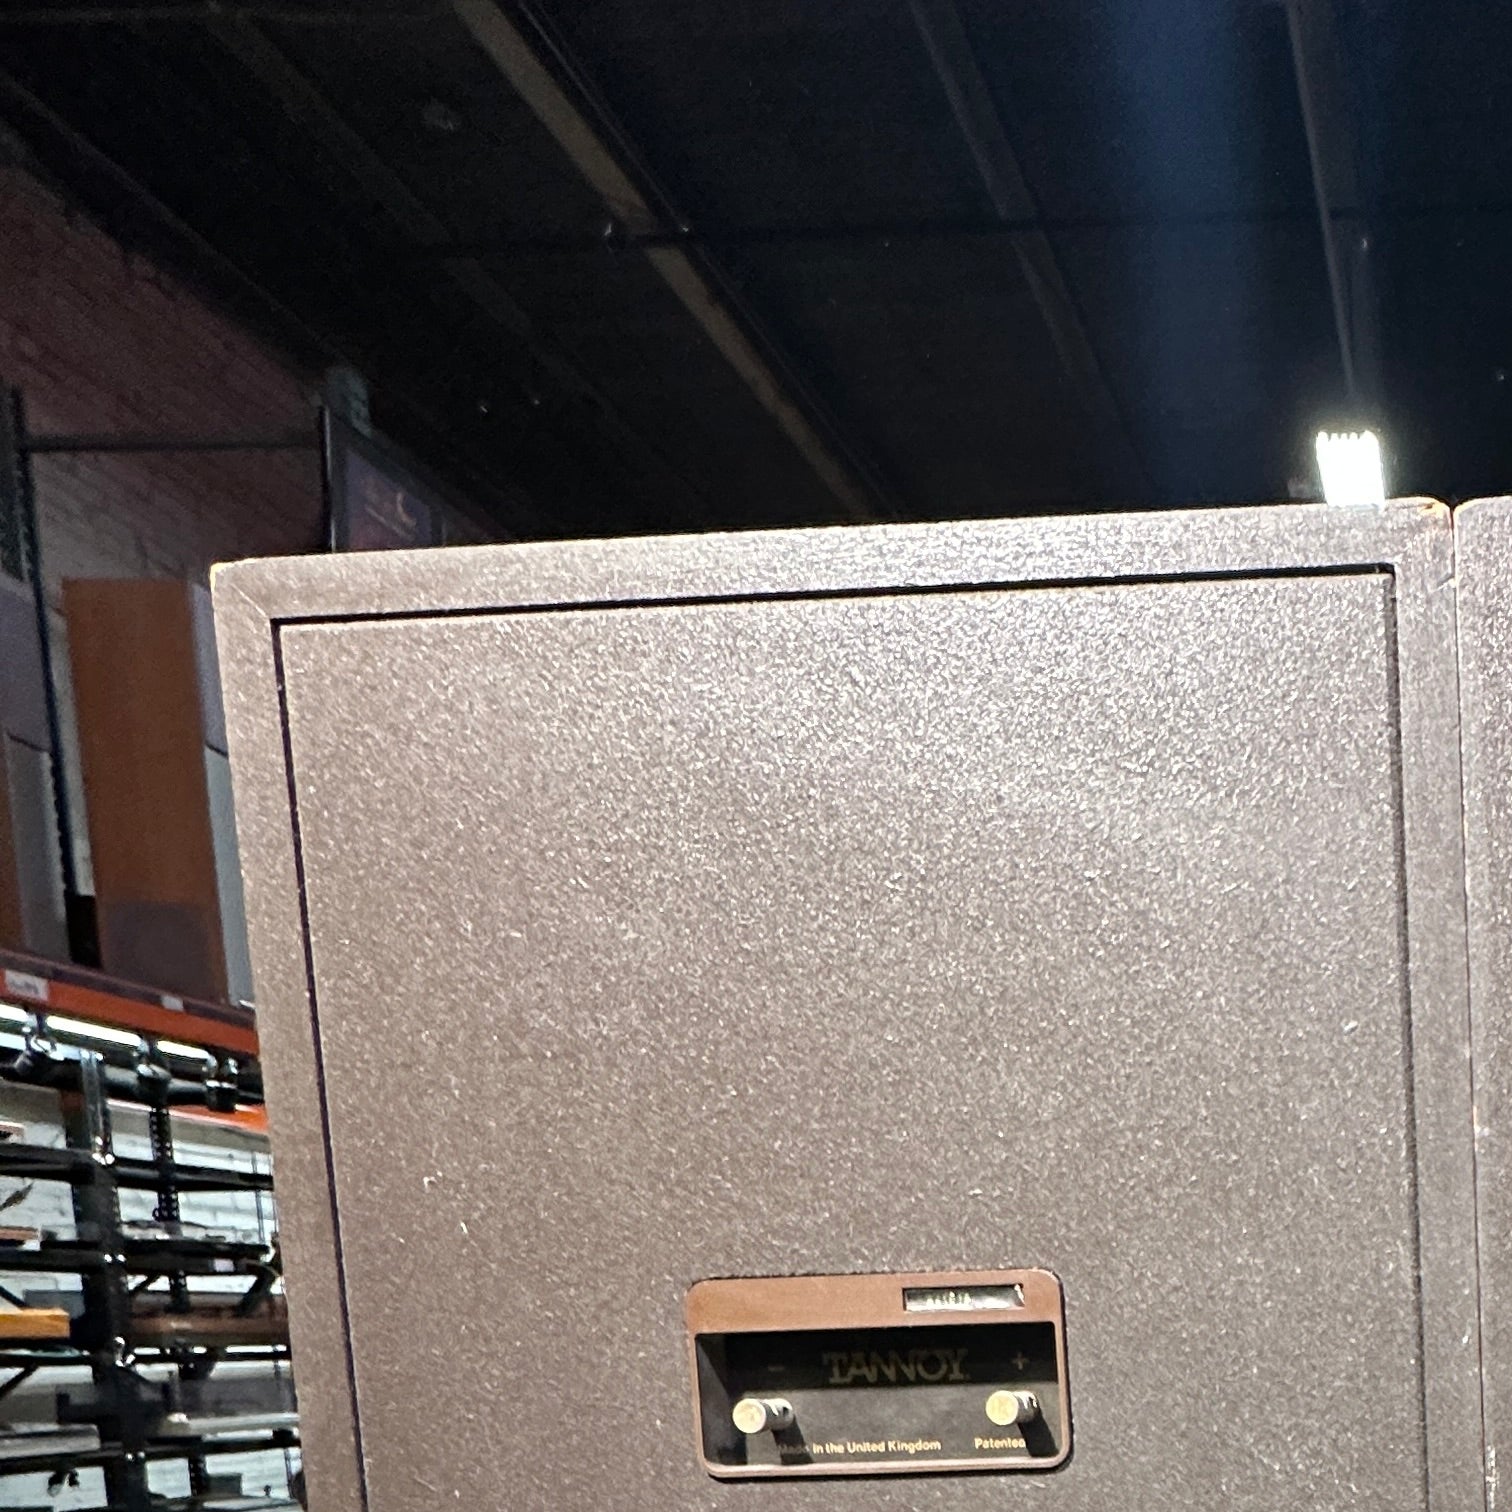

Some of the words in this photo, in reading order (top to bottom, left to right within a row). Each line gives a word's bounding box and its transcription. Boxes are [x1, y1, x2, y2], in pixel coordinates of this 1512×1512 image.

[822, 1347, 970, 1384] TANNOY
[825, 1440, 845, 1453] the
[846, 1439, 885, 1453] United
[888, 1438, 942, 1455] Kingdom
